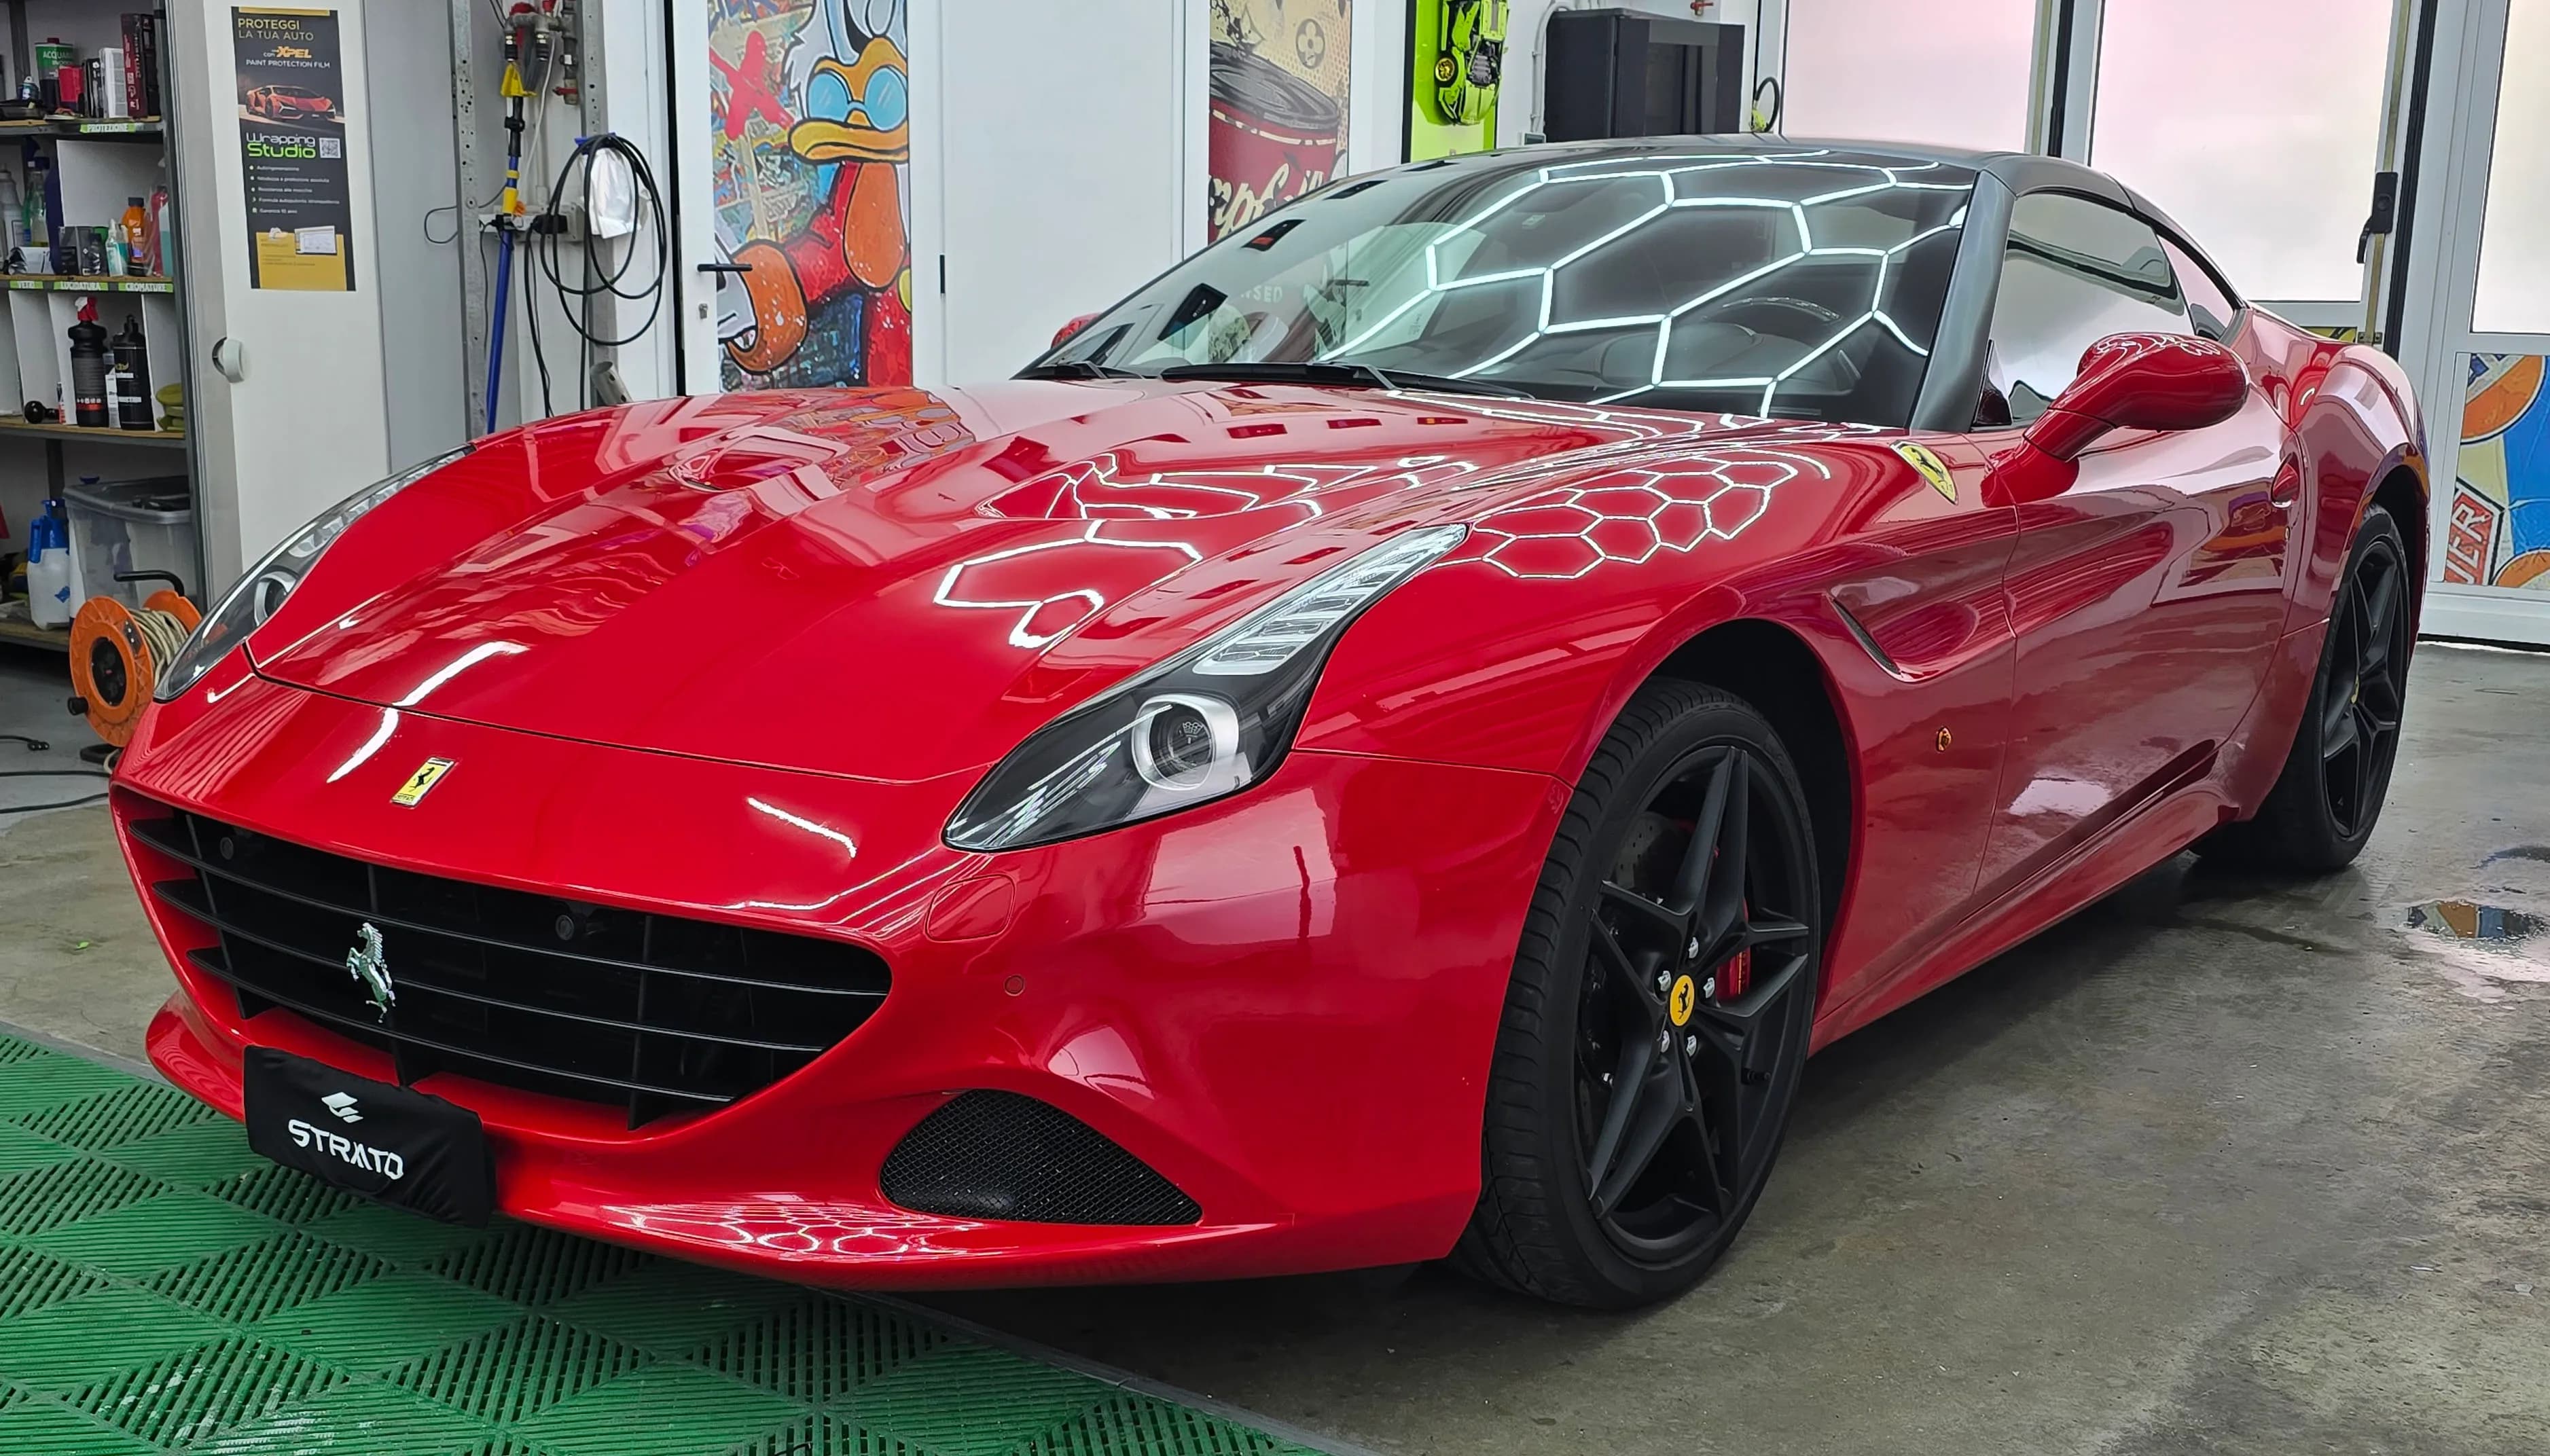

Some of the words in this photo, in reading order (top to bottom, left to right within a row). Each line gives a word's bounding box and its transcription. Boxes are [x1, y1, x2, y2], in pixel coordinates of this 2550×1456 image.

[238, 18, 300, 30] PROTEGGI
[238, 30, 253, 39] LA
[257, 31, 280, 39] TUA
[283, 32, 314, 41] AUTO
[274, 46, 312, 58] XPEL
[268, 60, 312, 68] PROTECTION
[246, 132, 316, 147] Wrapping
[247, 143, 317, 158] Studio
[288, 1119, 404, 1180] STRATO
